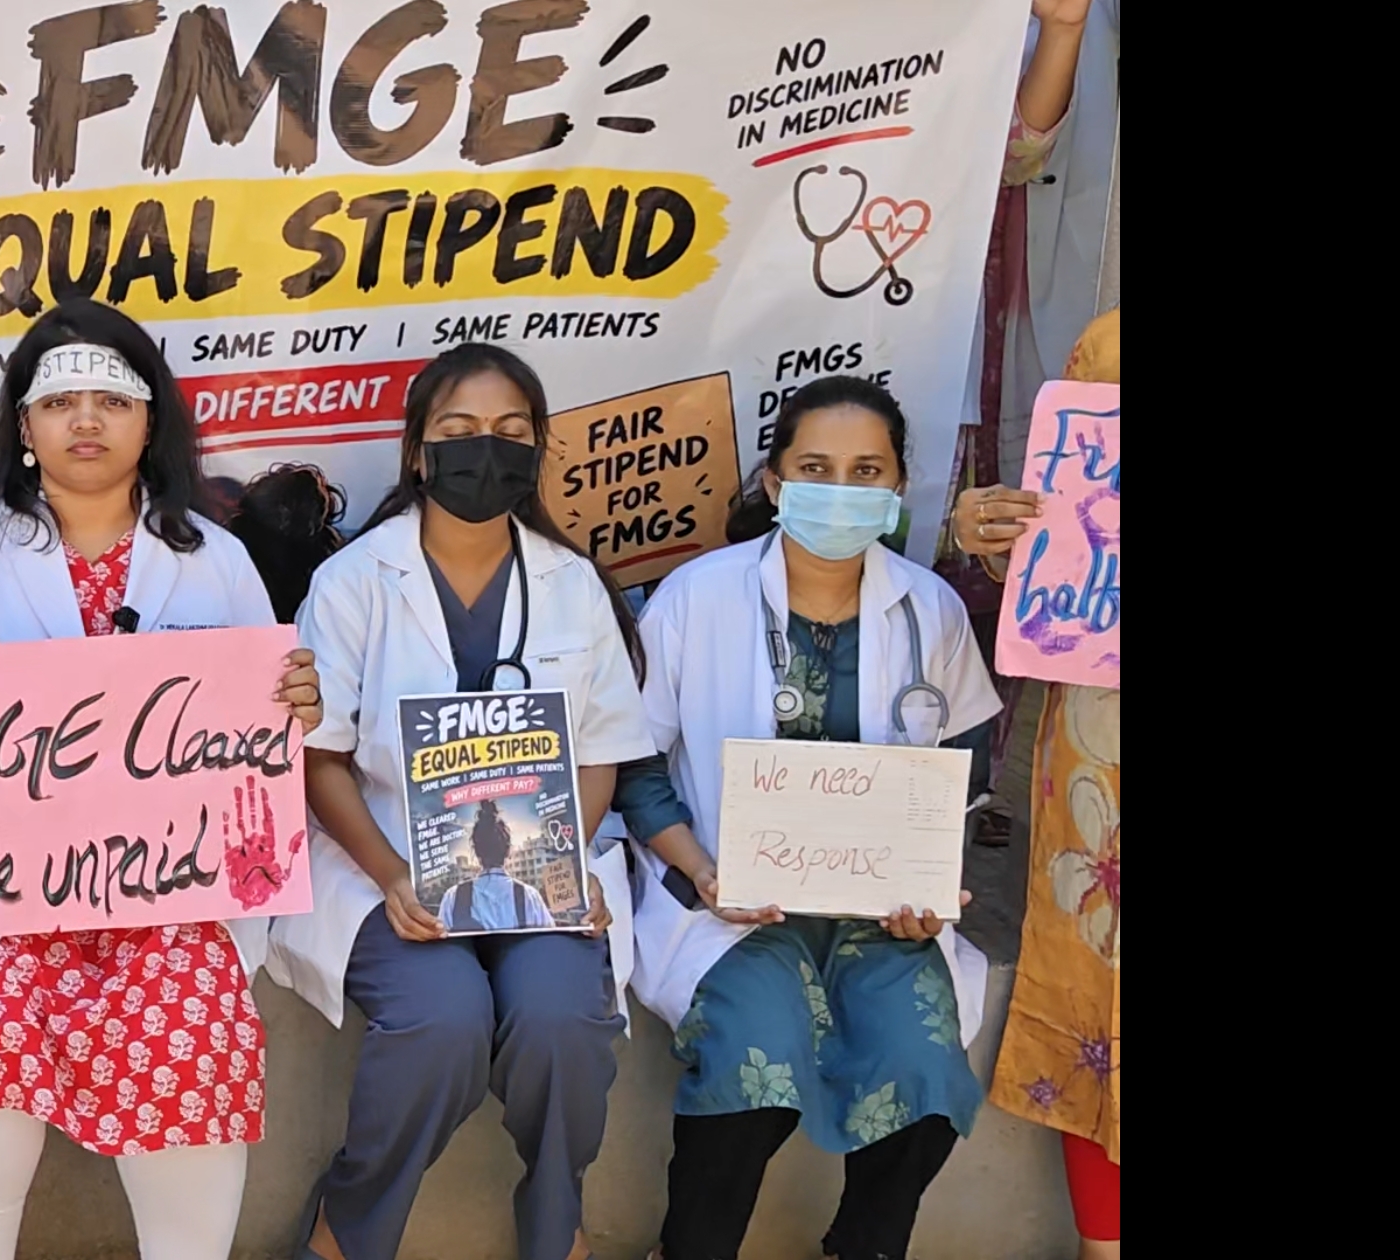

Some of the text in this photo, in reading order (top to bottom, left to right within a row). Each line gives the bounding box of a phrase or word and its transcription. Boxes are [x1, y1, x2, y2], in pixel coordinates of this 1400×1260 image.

[775, 38, 826, 75] NO
[26, 0, 590, 190] FMGE
[726, 50, 944, 119] DISCRIMINATION
[737, 89, 911, 149] IN MEDICINE
[280, 184, 696, 300] STIPEND
[191, 331, 273, 362] SAME
[290, 324, 367, 356] DUTY
[432, 314, 512, 345] SAME
[522, 312, 660, 340] PATIENTS
[775, 342, 863, 382] FMGS
[194, 375, 391, 423] DIFFERENT
[588, 406, 664, 453] FAIR
[563, 435, 708, 498] STIPEND
[607, 481, 663, 516] FOR
[589, 504, 697, 558] FMGS
[438, 695, 529, 743] FMGE
[420, 736, 553, 776] EQUAL STIPEND
[810, 760, 881, 796] need
[42, 804, 221, 917] unpaid
[750, 830, 892, 886] Response
